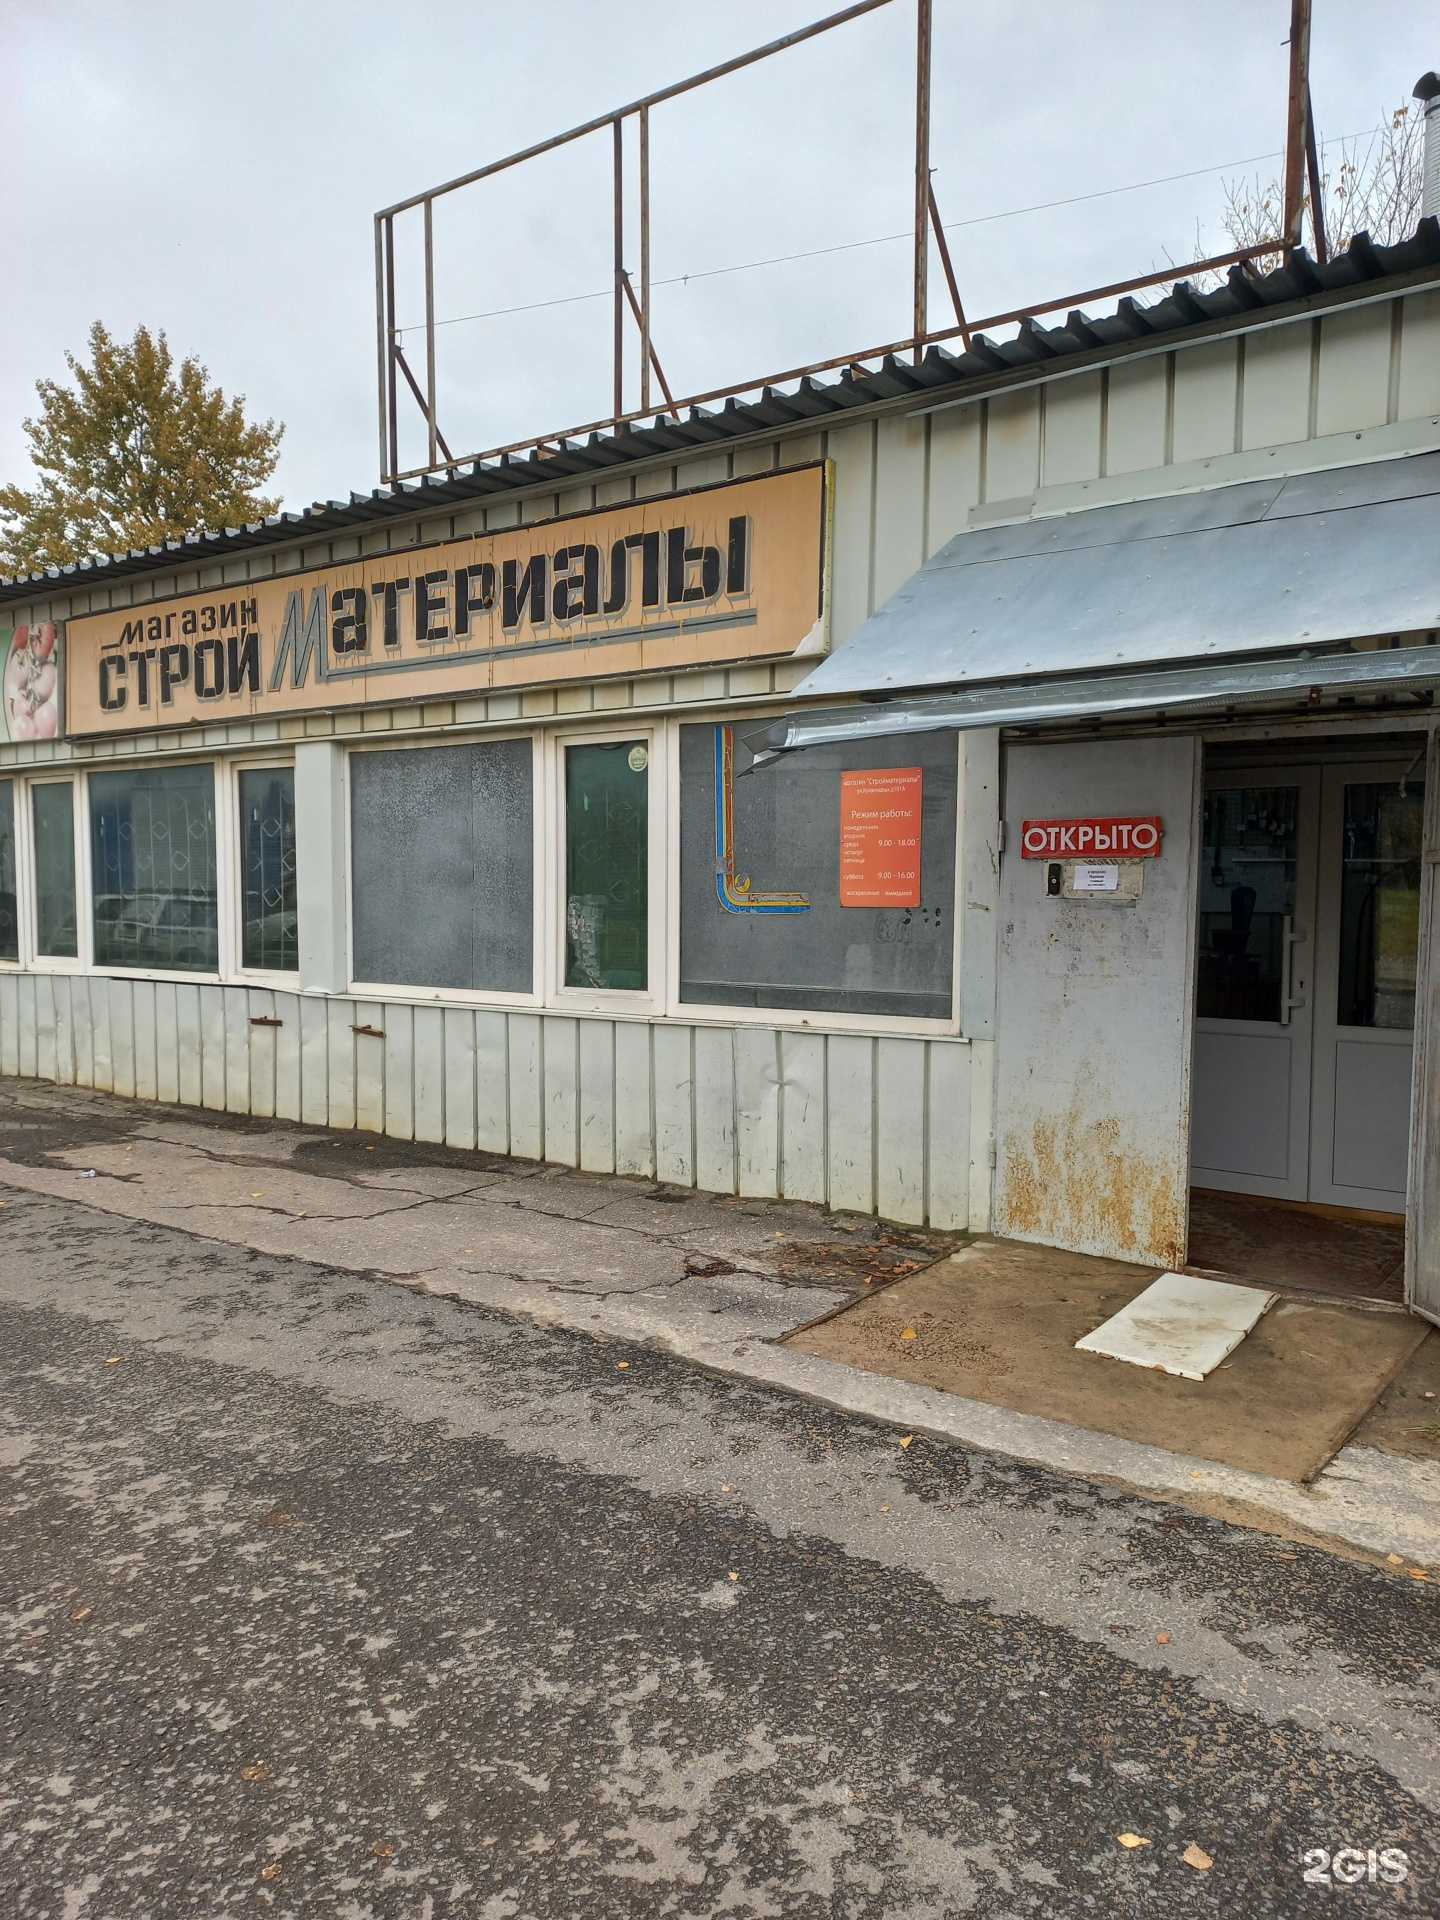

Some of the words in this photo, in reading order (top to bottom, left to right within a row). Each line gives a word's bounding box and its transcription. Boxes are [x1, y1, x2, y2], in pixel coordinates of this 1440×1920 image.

[101, 597, 257, 649] магазин
[852, 810, 878, 820] Режим
[878, 839, 892, 847] 9.00
[1024, 823, 1158, 852] ОТКРЫТО
